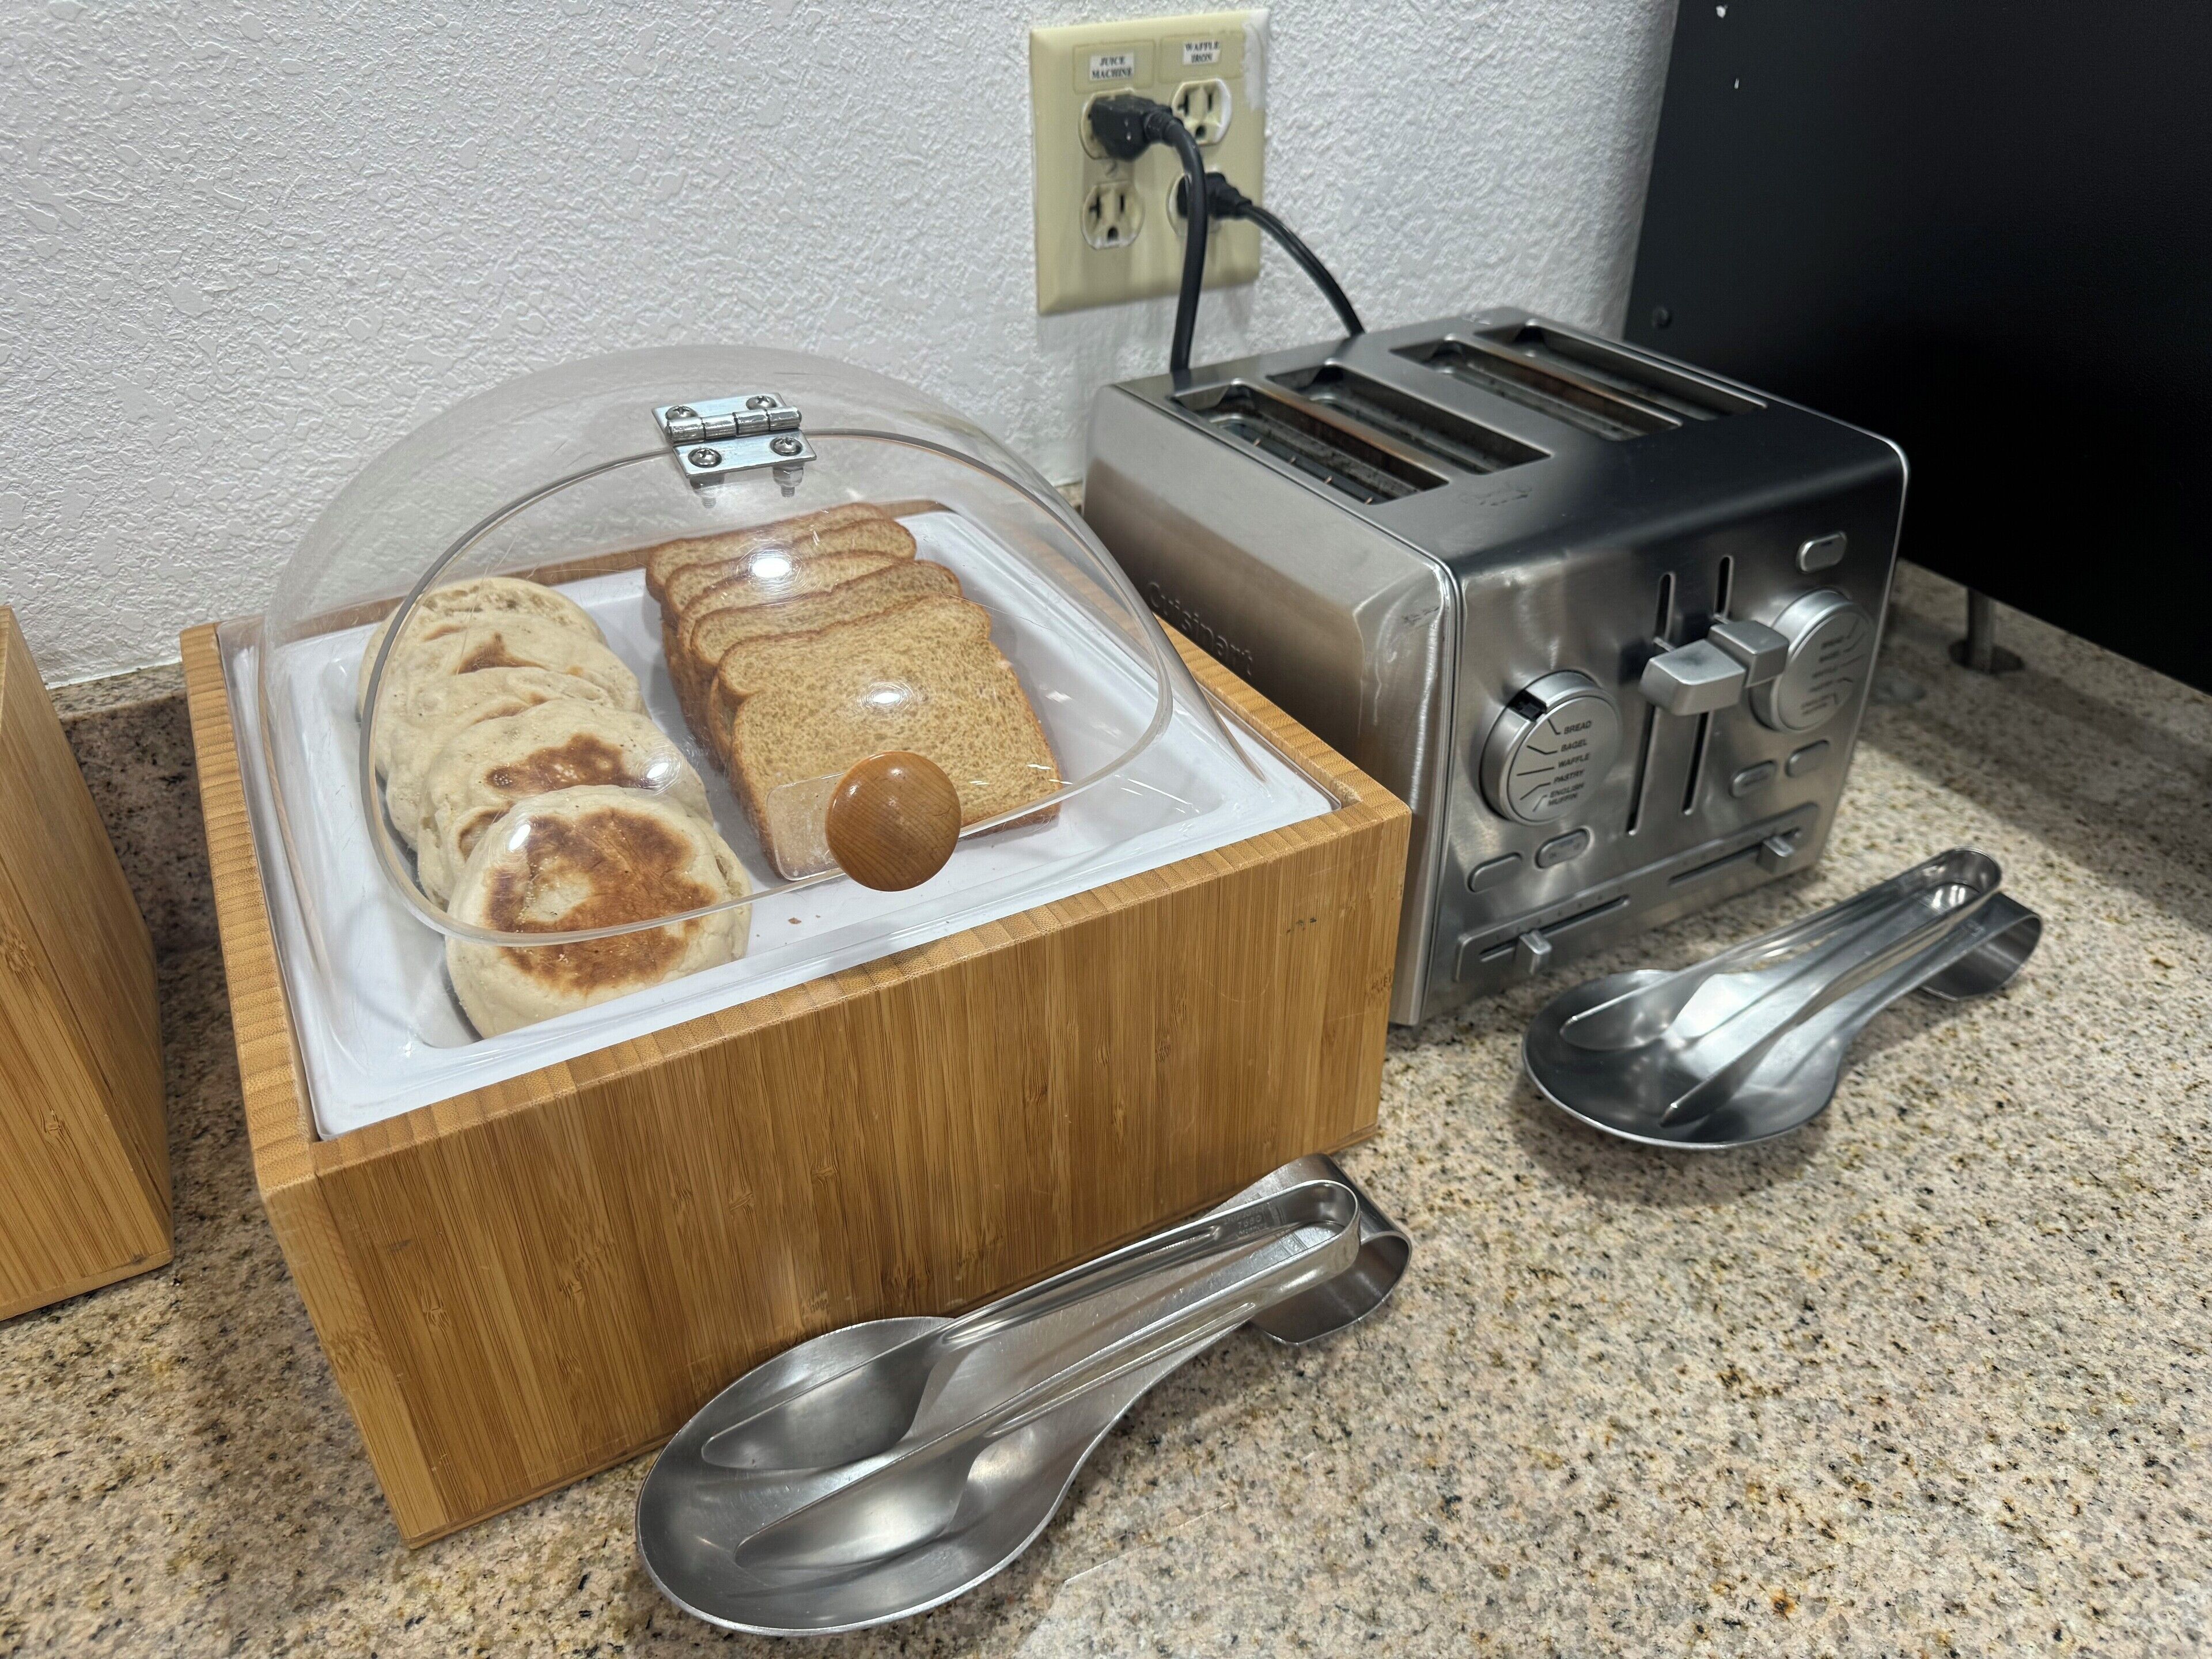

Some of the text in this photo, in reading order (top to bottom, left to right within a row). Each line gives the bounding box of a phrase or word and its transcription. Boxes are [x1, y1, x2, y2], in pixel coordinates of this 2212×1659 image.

[1185, 41, 1220, 51] WAFFLE
[1100, 56, 1126, 66] JUICE
[1191, 54, 1213, 63] IRON
[1092, 68, 1132, 79] MACHINE
[1563, 720, 1592, 734] BREAD
[1560, 739, 1588, 752] BAGEL
[1558, 753, 1590, 768] WAFFLE
[1554, 770, 1585, 783] PASTRY
[1550, 783, 1584, 798] ENGLISH
[1548, 793, 1578, 806] MUFFIN
